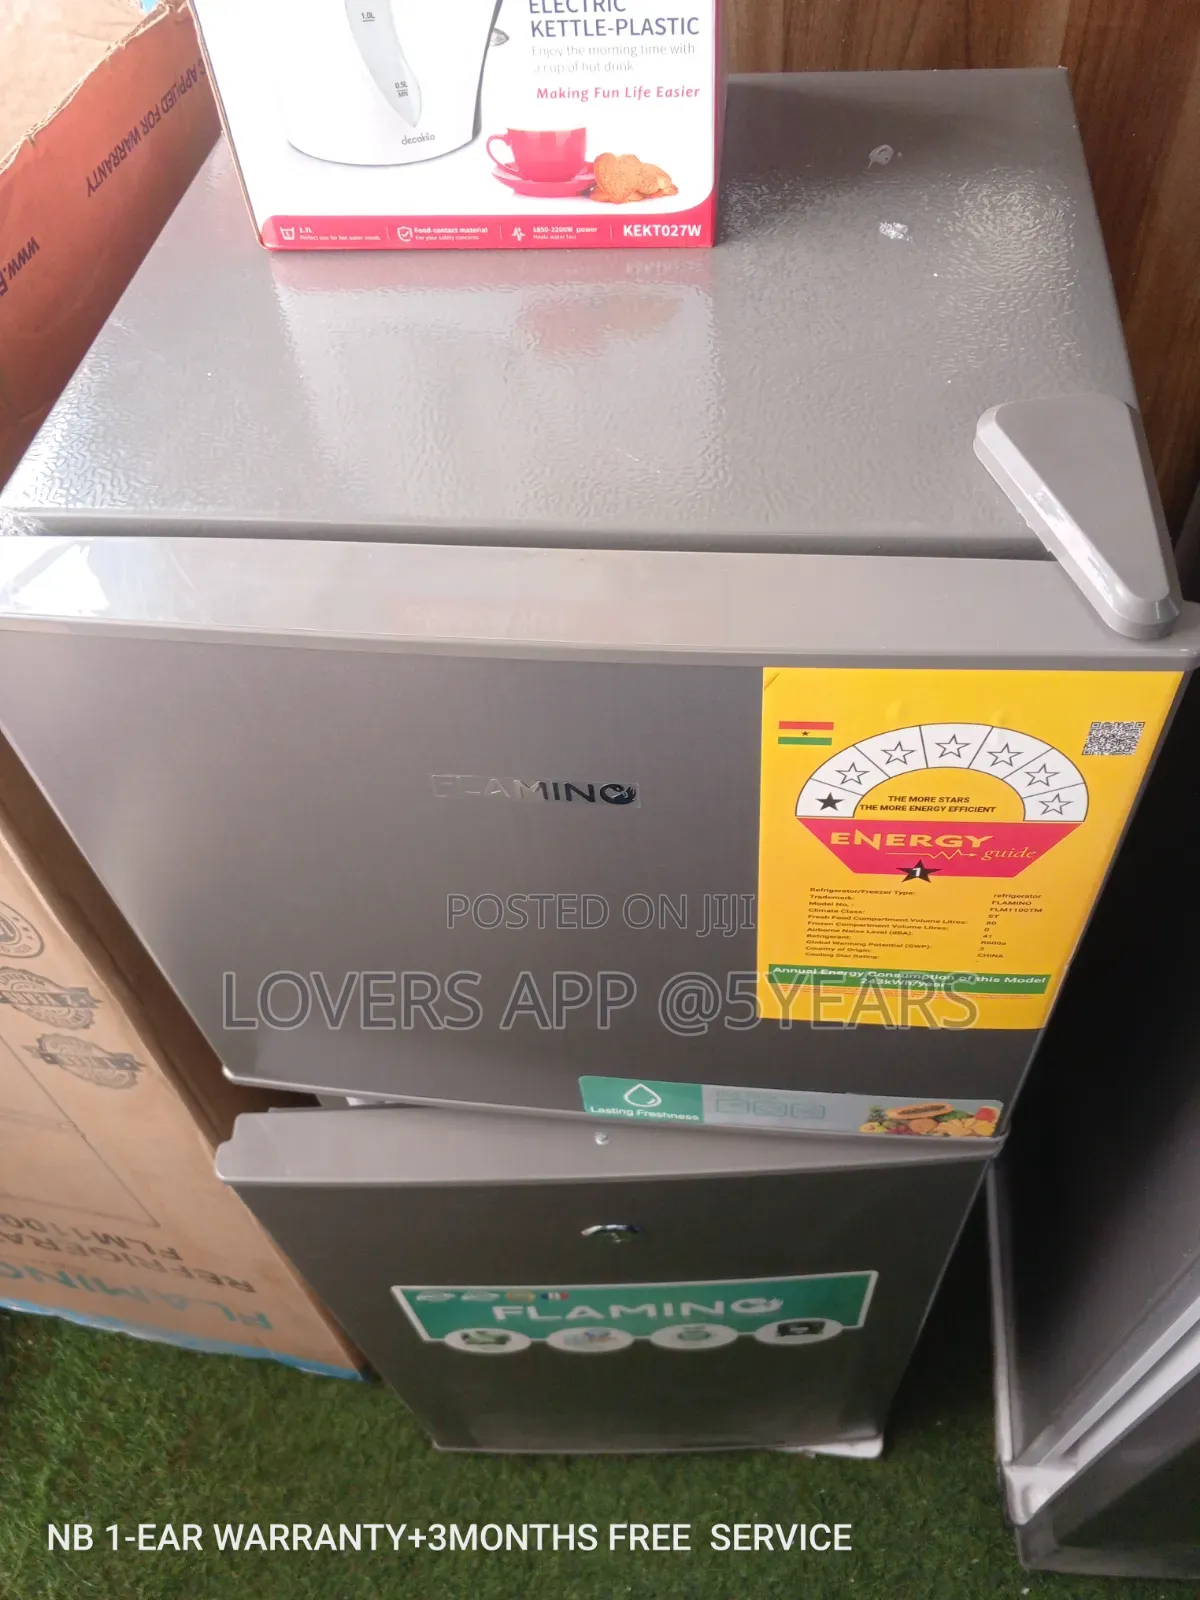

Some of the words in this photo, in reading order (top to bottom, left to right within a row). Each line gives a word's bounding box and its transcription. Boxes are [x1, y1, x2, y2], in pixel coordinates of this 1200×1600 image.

[529, 0, 626, 14] ELECTRIC
[530, 17, 700, 37] KETTLE-PLASTIC
[532, 45, 563, 58] Enjoy
[566, 45, 585, 56] the
[588, 45, 638, 58] morning
[641, 44, 667, 55] time
[670, 43, 695, 55] with
[543, 64, 565, 75] cup
[568, 61, 580, 73] of
[581, 61, 601, 72] hot
[604, 60, 634, 72] drink
[161, 63, 197, 114] APPLIED
[537, 87, 589, 102] Making
[594, 87, 619, 99] Fun
[625, 86, 651, 100] Life
[656, 86, 700, 98] Easier
[140, 103, 161, 136] FOR
[86, 126, 142, 197] WARRANTY
[623, 224, 701, 238] KEKT027W
[888, 795, 906, 803] THE
[881, 804, 907, 812] MORE
[830, 828, 994, 850] ENERGY
[981, 847, 1037, 861] guide
[912, 867, 921, 877] 1
[773, 966, 817, 975] Annual
[819, 968, 864, 978] Energy
[590, 1105, 634, 1117] Lasting
[637, 1109, 700, 1121] Freshness
